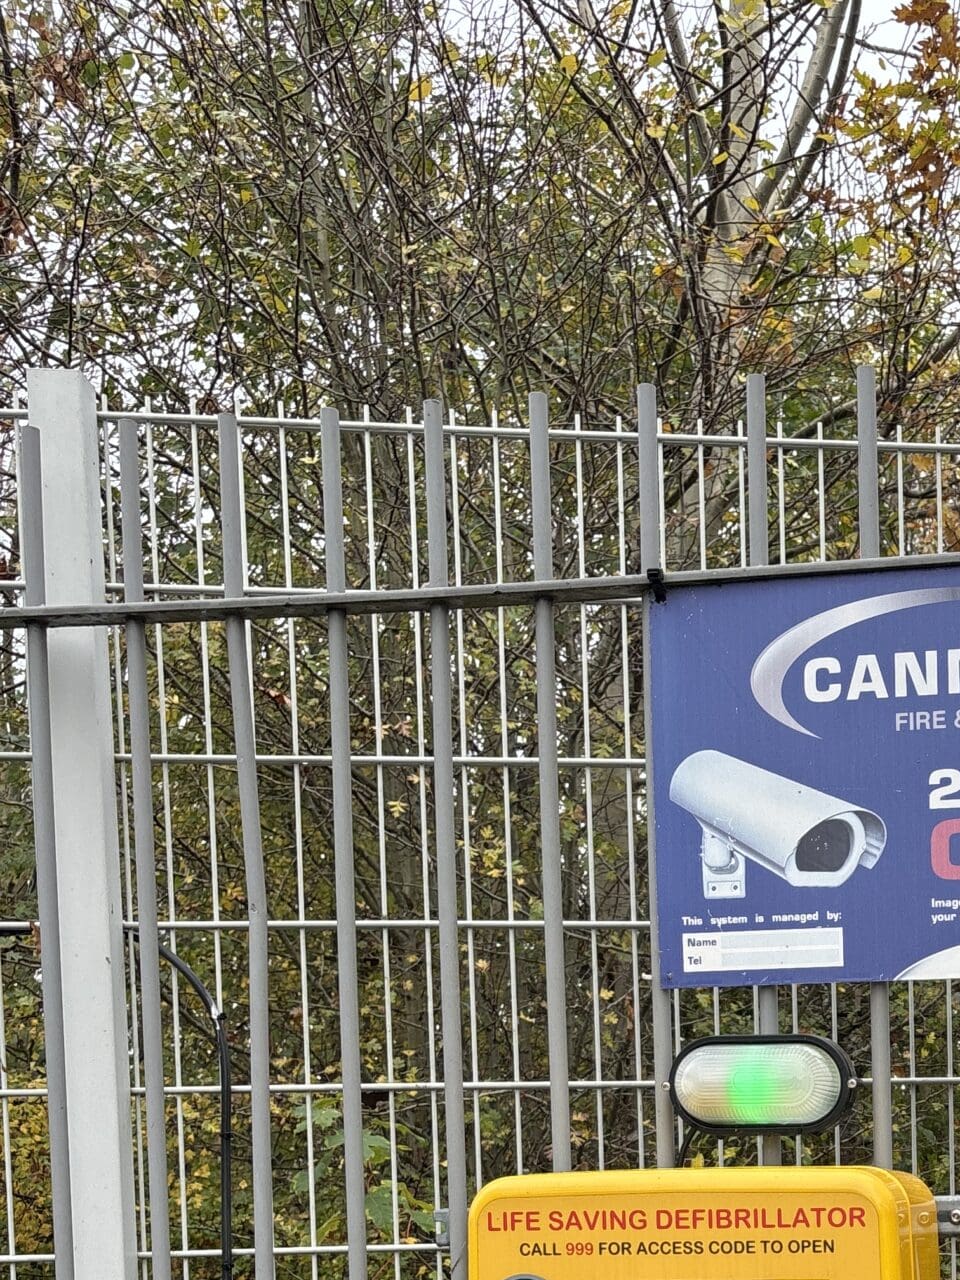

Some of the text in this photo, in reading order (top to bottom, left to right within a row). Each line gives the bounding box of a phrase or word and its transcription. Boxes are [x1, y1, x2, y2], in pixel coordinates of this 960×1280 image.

[895, 709, 948, 732] FIRE
[682, 910, 842, 928] This system is managed by:
[931, 912, 956, 925] your
[687, 938, 717, 947] Name
[688, 956, 702, 965] Tel
[486, 1206, 866, 1232] LIFE SAVING DEFIBRILLATOR
[519, 1239, 835, 1257] CALL 999 FOR ACCESS CODE TO OPEN
